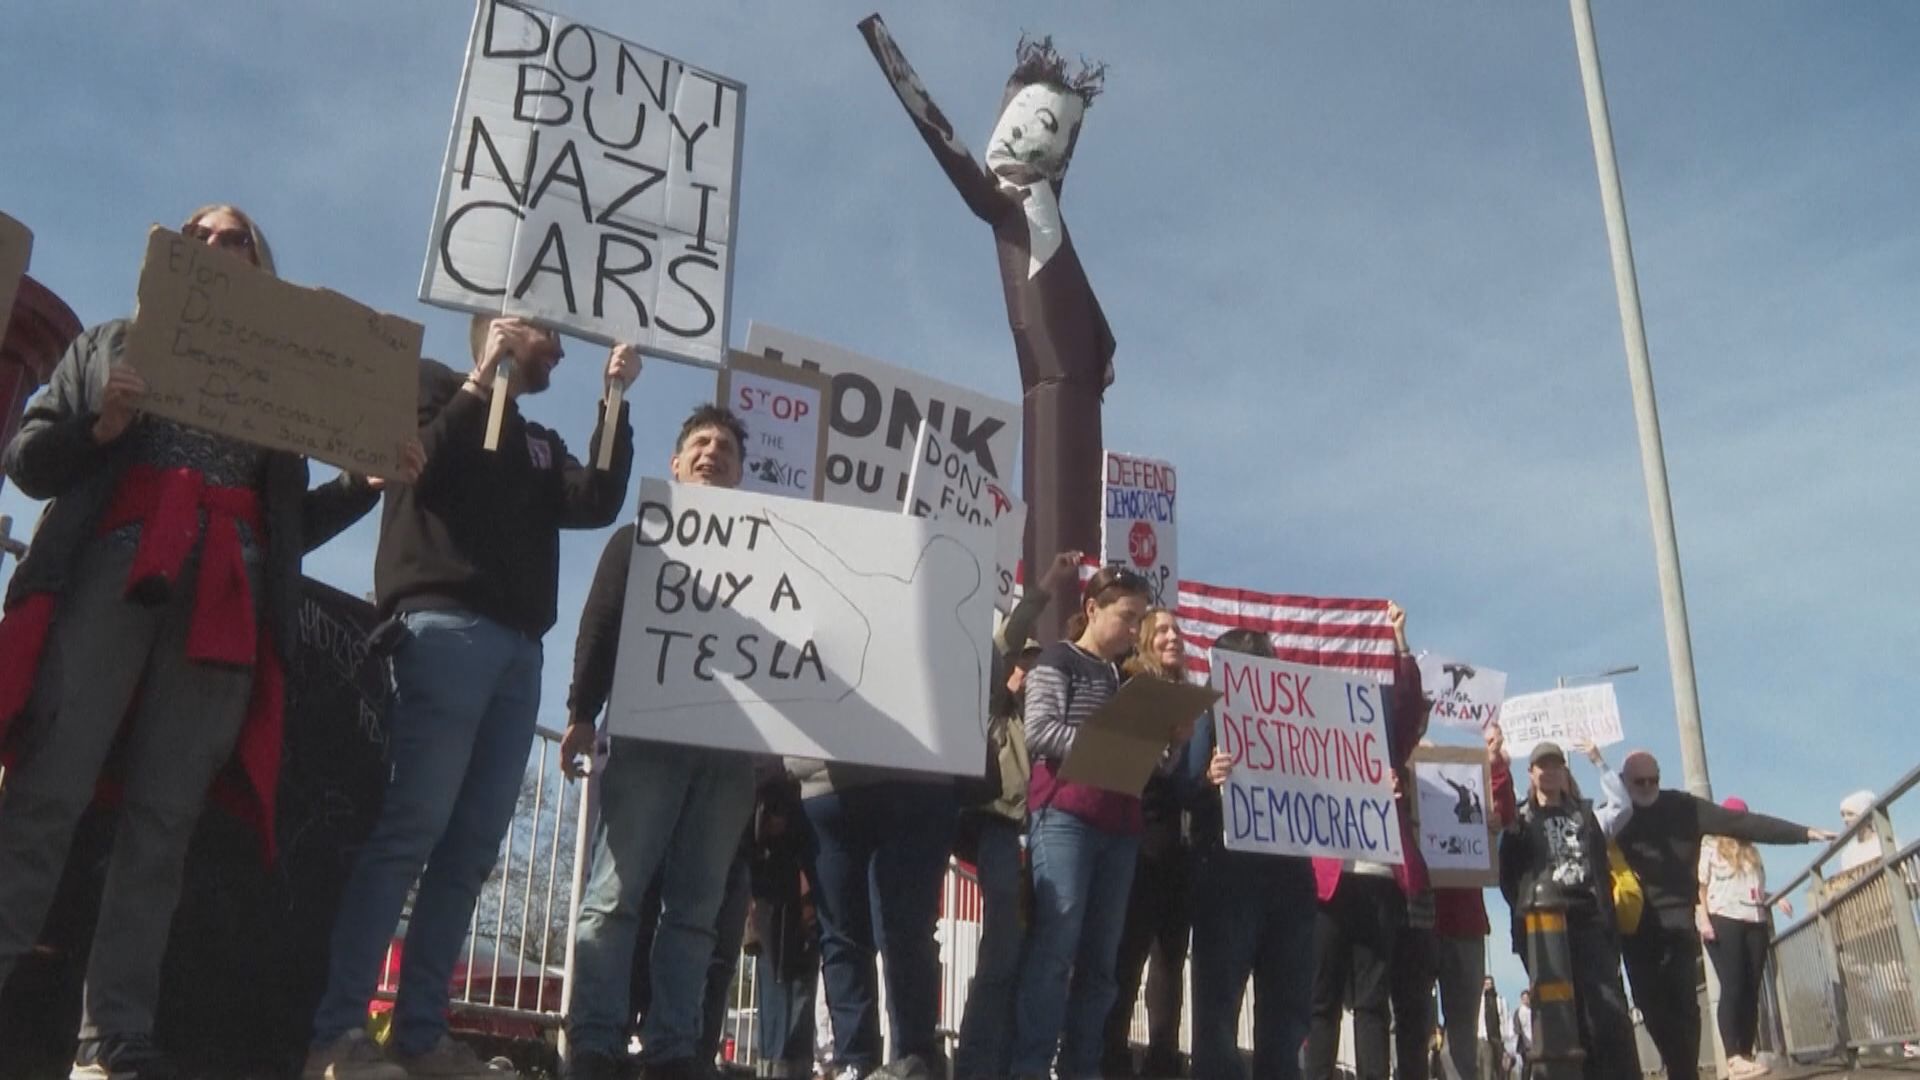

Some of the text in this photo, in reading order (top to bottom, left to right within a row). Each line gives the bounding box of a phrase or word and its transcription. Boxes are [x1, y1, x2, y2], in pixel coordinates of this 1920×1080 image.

[483, 0, 738, 128] DON'T
[513, 63, 709, 171] BUY
[461, 116, 718, 256] NAZI
[169, 238, 230, 293] Elon
[439, 200, 719, 337] CARS
[740, 386, 809, 422] STOP
[764, 346, 1006, 480] ONK
[760, 431, 785, 450] THE
[825, 454, 885, 493] OU
[1107, 454, 1177, 496] DEFEND
[636, 501, 771, 550] DON'T
[1106, 488, 1176, 524] DEMOCRACY
[1129, 533, 1155, 557] STOP
[655, 560, 802, 614] BUY A
[645, 627, 826, 686] TESLA
[1223, 661, 1376, 725] MUSK IS
[1223, 713, 1383, 785] DESTROYING
[1230, 782, 1391, 852] DEMOCRACY
[1426, 833, 1484, 857] TXIC
